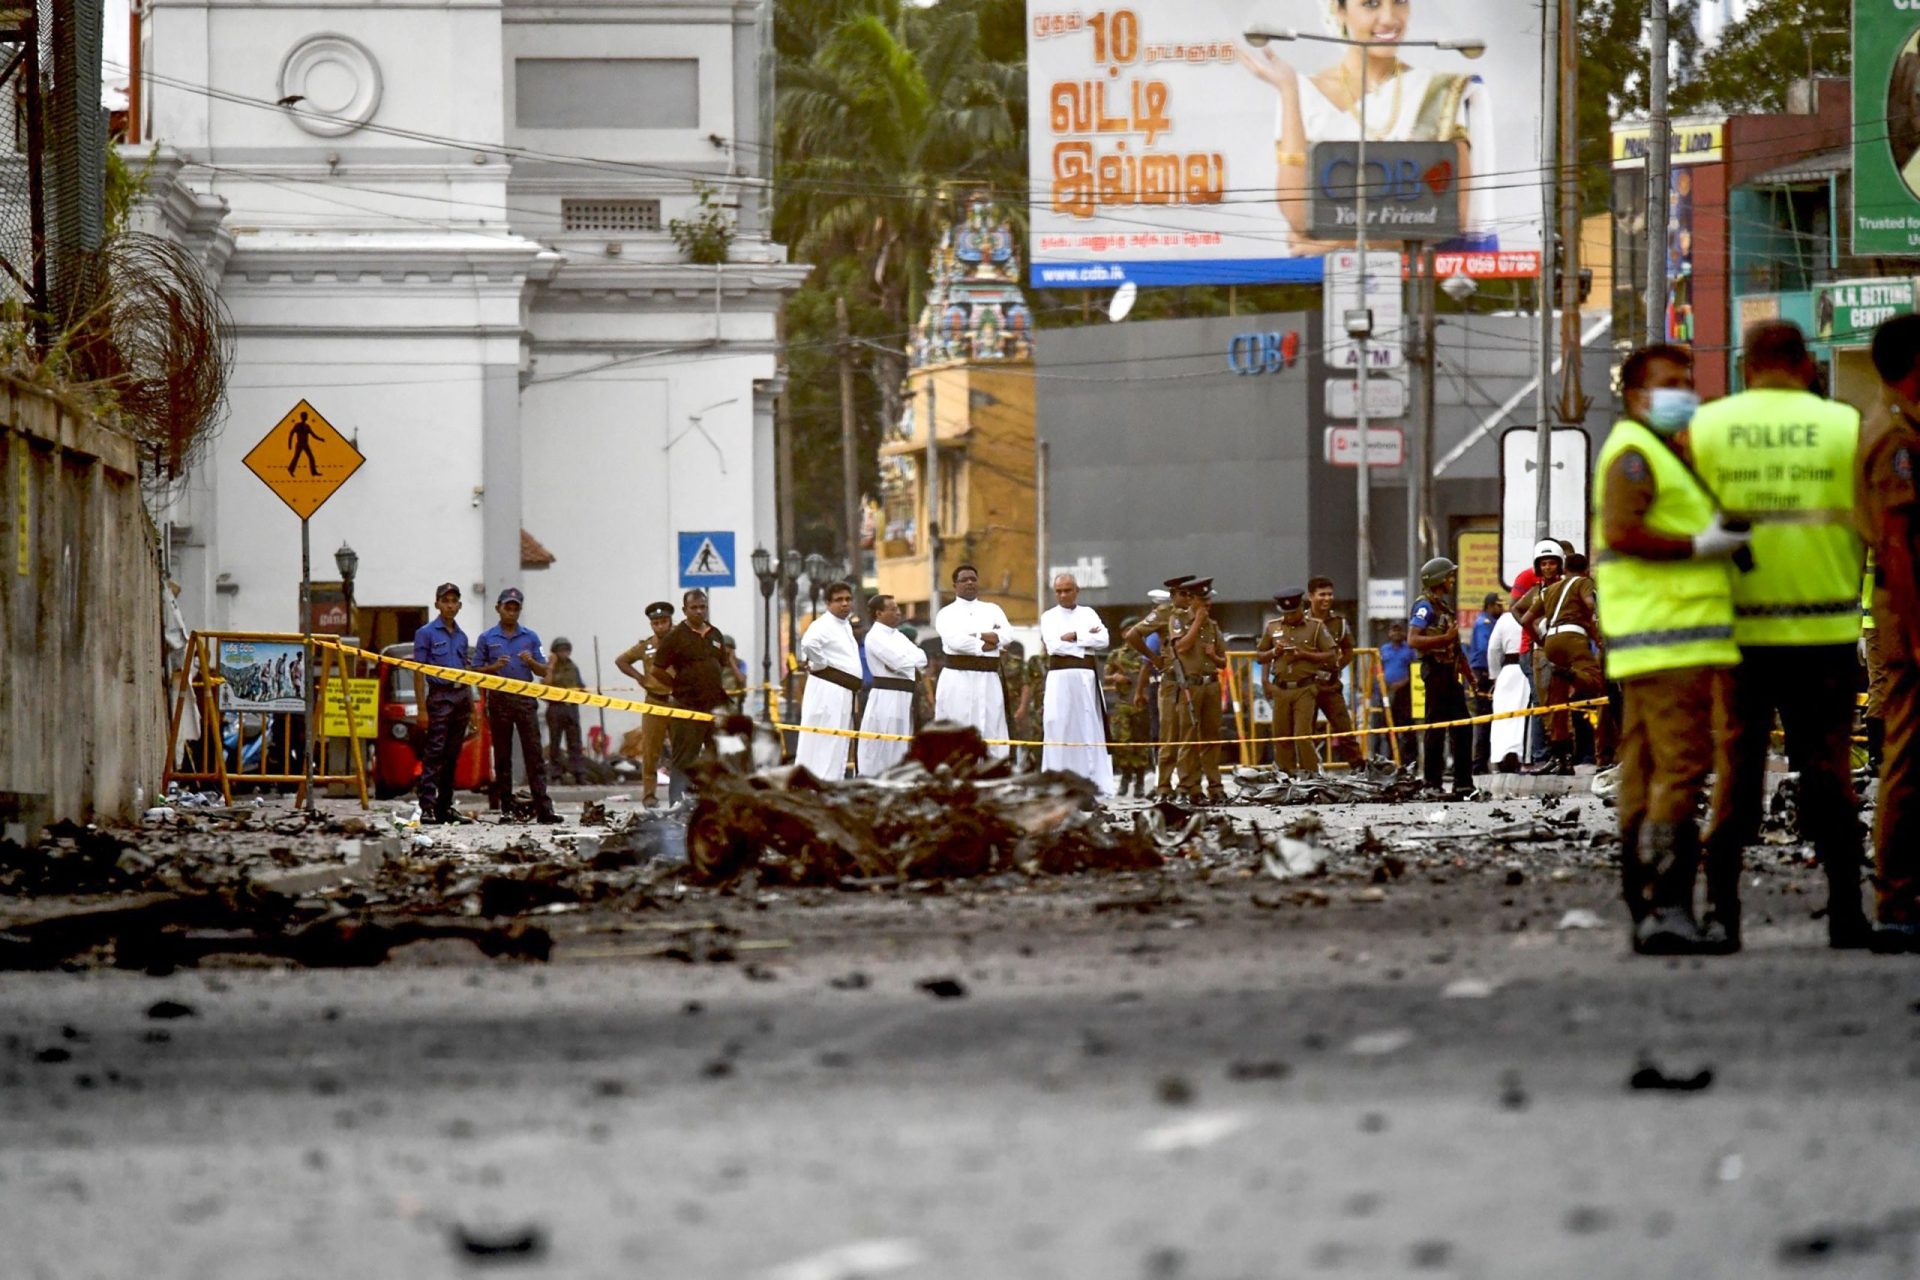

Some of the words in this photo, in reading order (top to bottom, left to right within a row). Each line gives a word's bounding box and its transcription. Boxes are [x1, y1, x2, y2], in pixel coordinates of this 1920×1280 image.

[1087, 10, 1138, 64] 10
[1052, 65, 1170, 145] வட்டி
[1053, 141, 1224, 219] இல்லை
[1320, 158, 1422, 202] CDB
[1335, 206, 1375, 225] Yor
[1380, 205, 1438, 224] Friend
[1860, 217, 1905, 229] Trusted
[1041, 264, 1125, 281] www.cdb.lk
[1435, 255, 1464, 274] 077
[1861, 284, 1912, 305] BETTING
[1228, 332, 1283, 375] CDB
[1346, 351, 1390, 365] AM
[1728, 424, 1818, 448] POLICE
